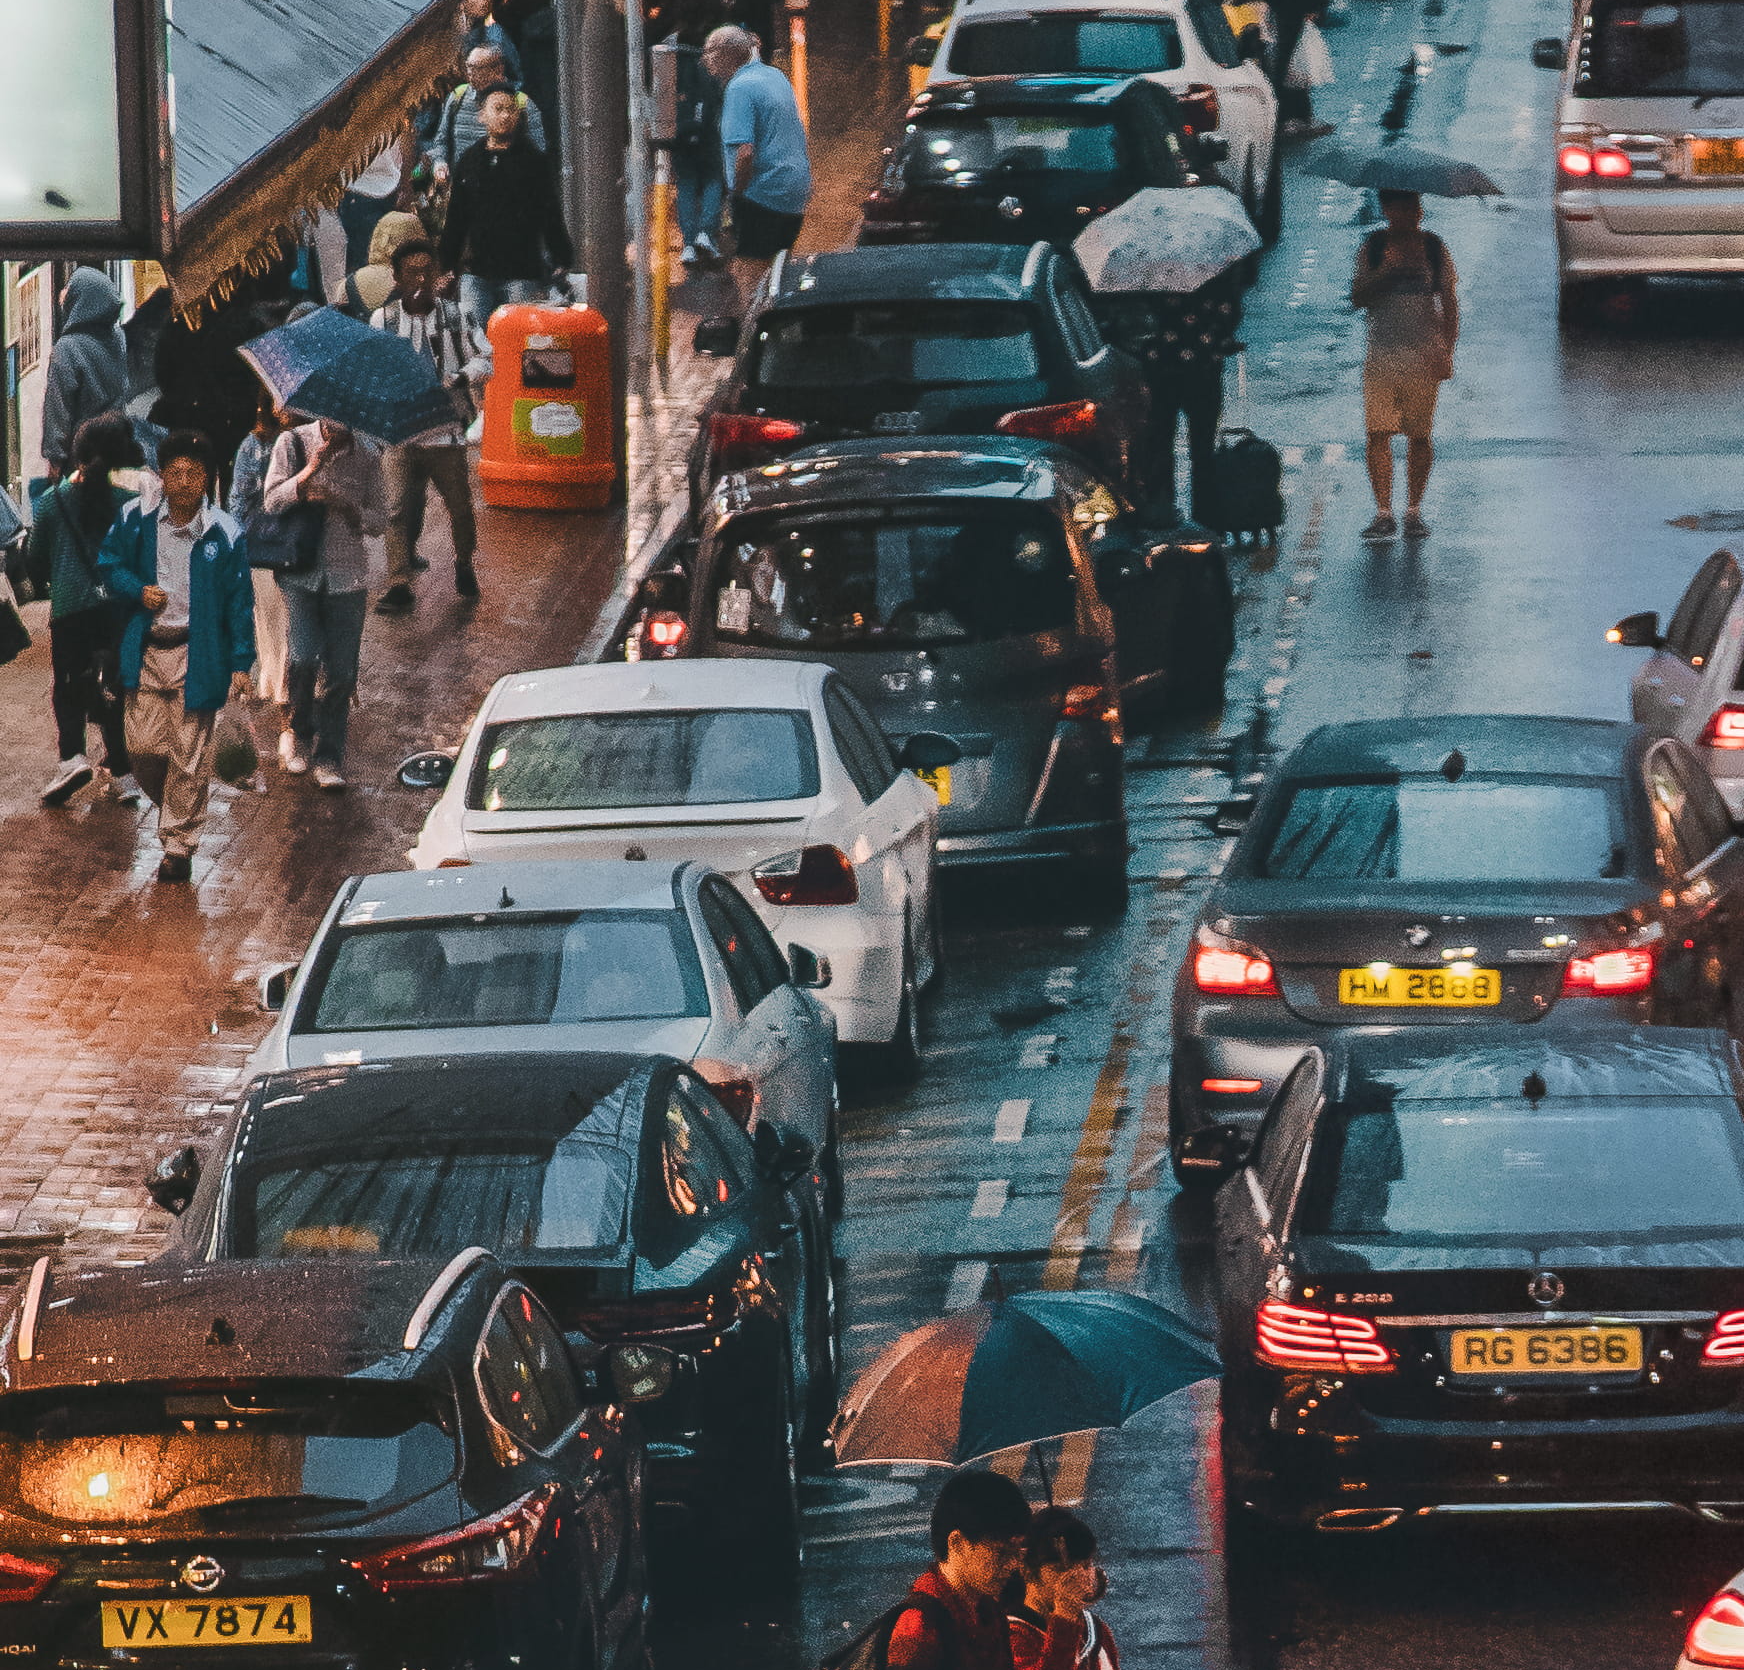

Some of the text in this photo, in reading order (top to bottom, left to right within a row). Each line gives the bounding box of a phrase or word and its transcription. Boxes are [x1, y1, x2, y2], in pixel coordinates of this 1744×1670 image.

[1464, 1334, 1628, 1367] RG 6386
[116, 1592, 298, 1640] VX 7874
